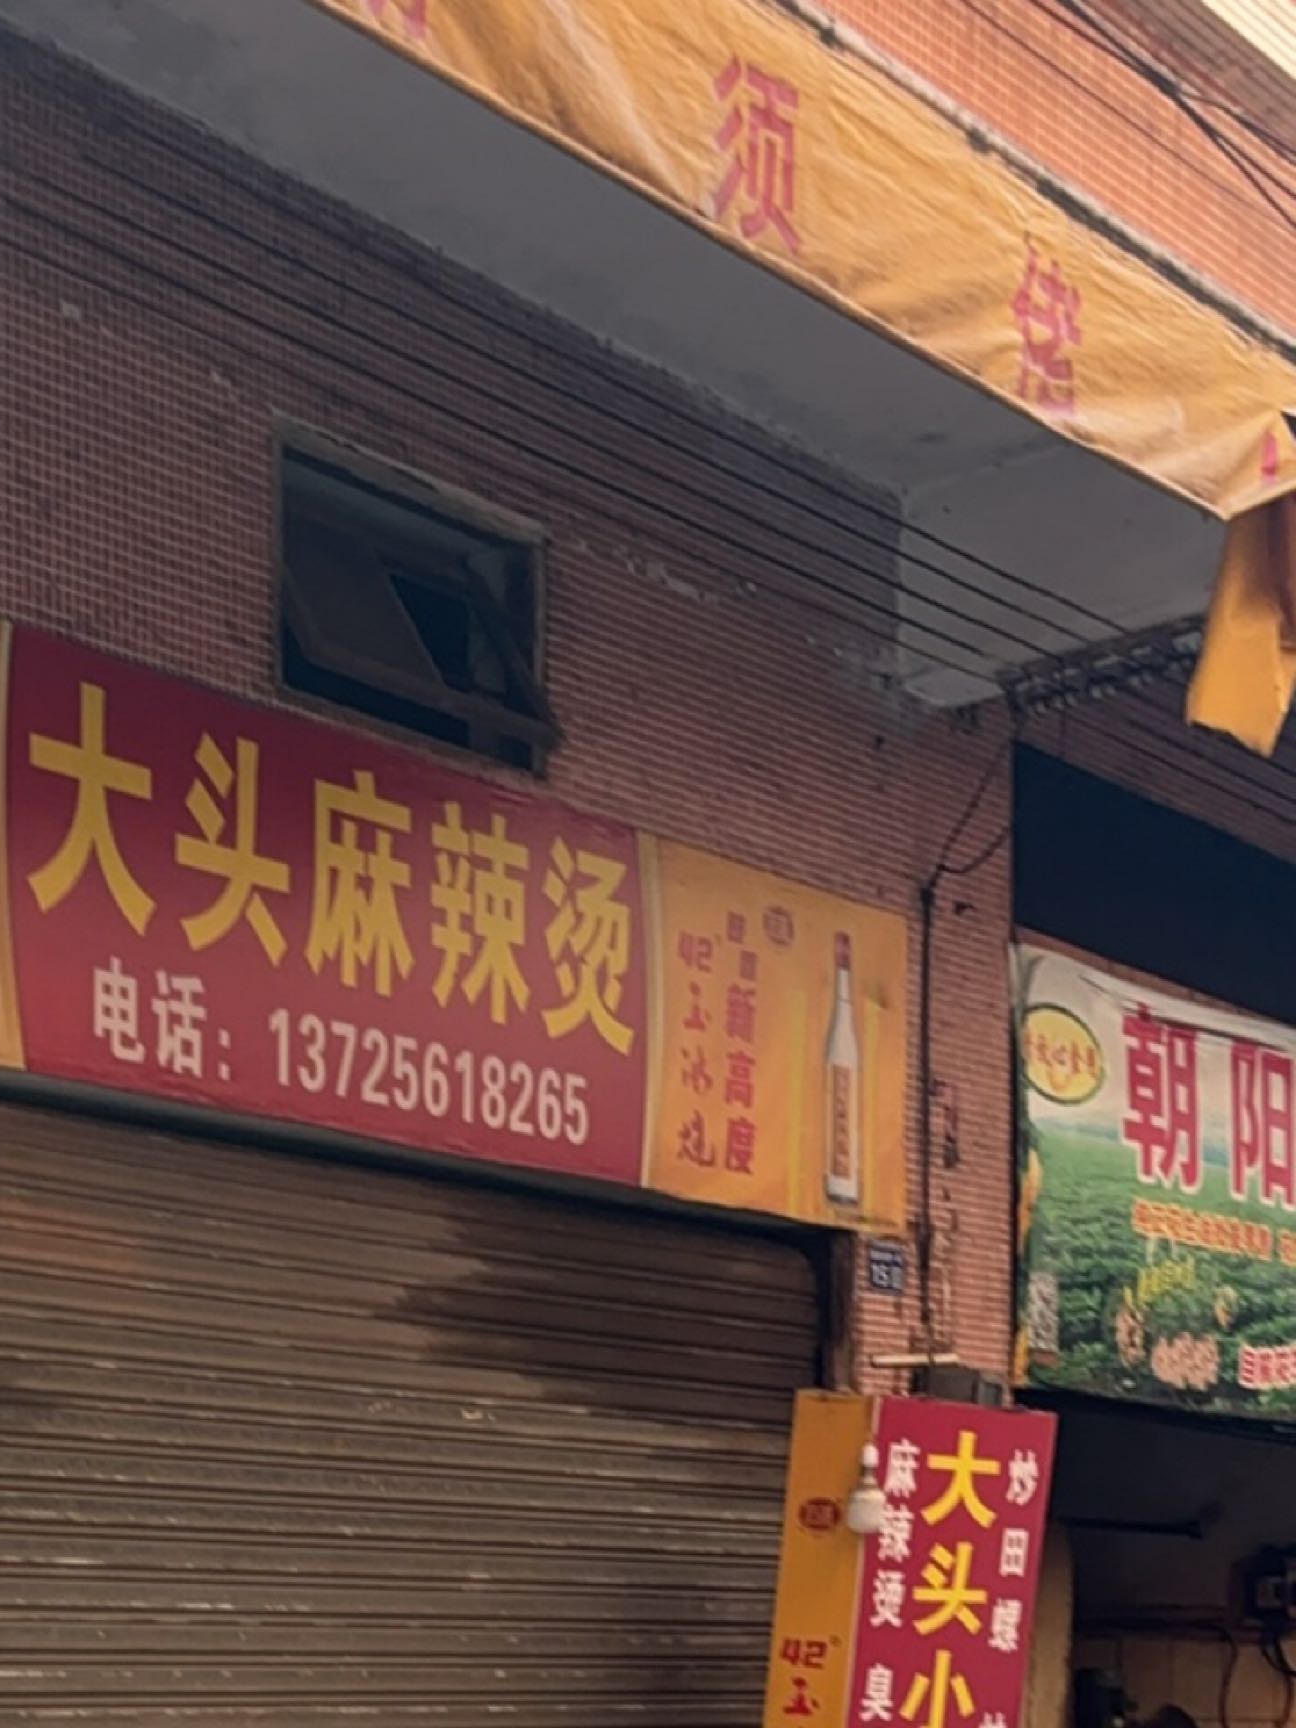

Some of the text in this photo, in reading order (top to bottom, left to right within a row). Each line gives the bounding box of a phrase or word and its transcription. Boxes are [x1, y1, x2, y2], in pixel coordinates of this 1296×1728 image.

[713, 54, 801, 257] 须
[27, 682, 636, 1057] 大头麻辣烫
[269, 1008, 589, 1147] 13725618265
[1123, 1001, 1293, 1206] 朝阳
[870, 1438, 921, 1628] 麻辣烫
